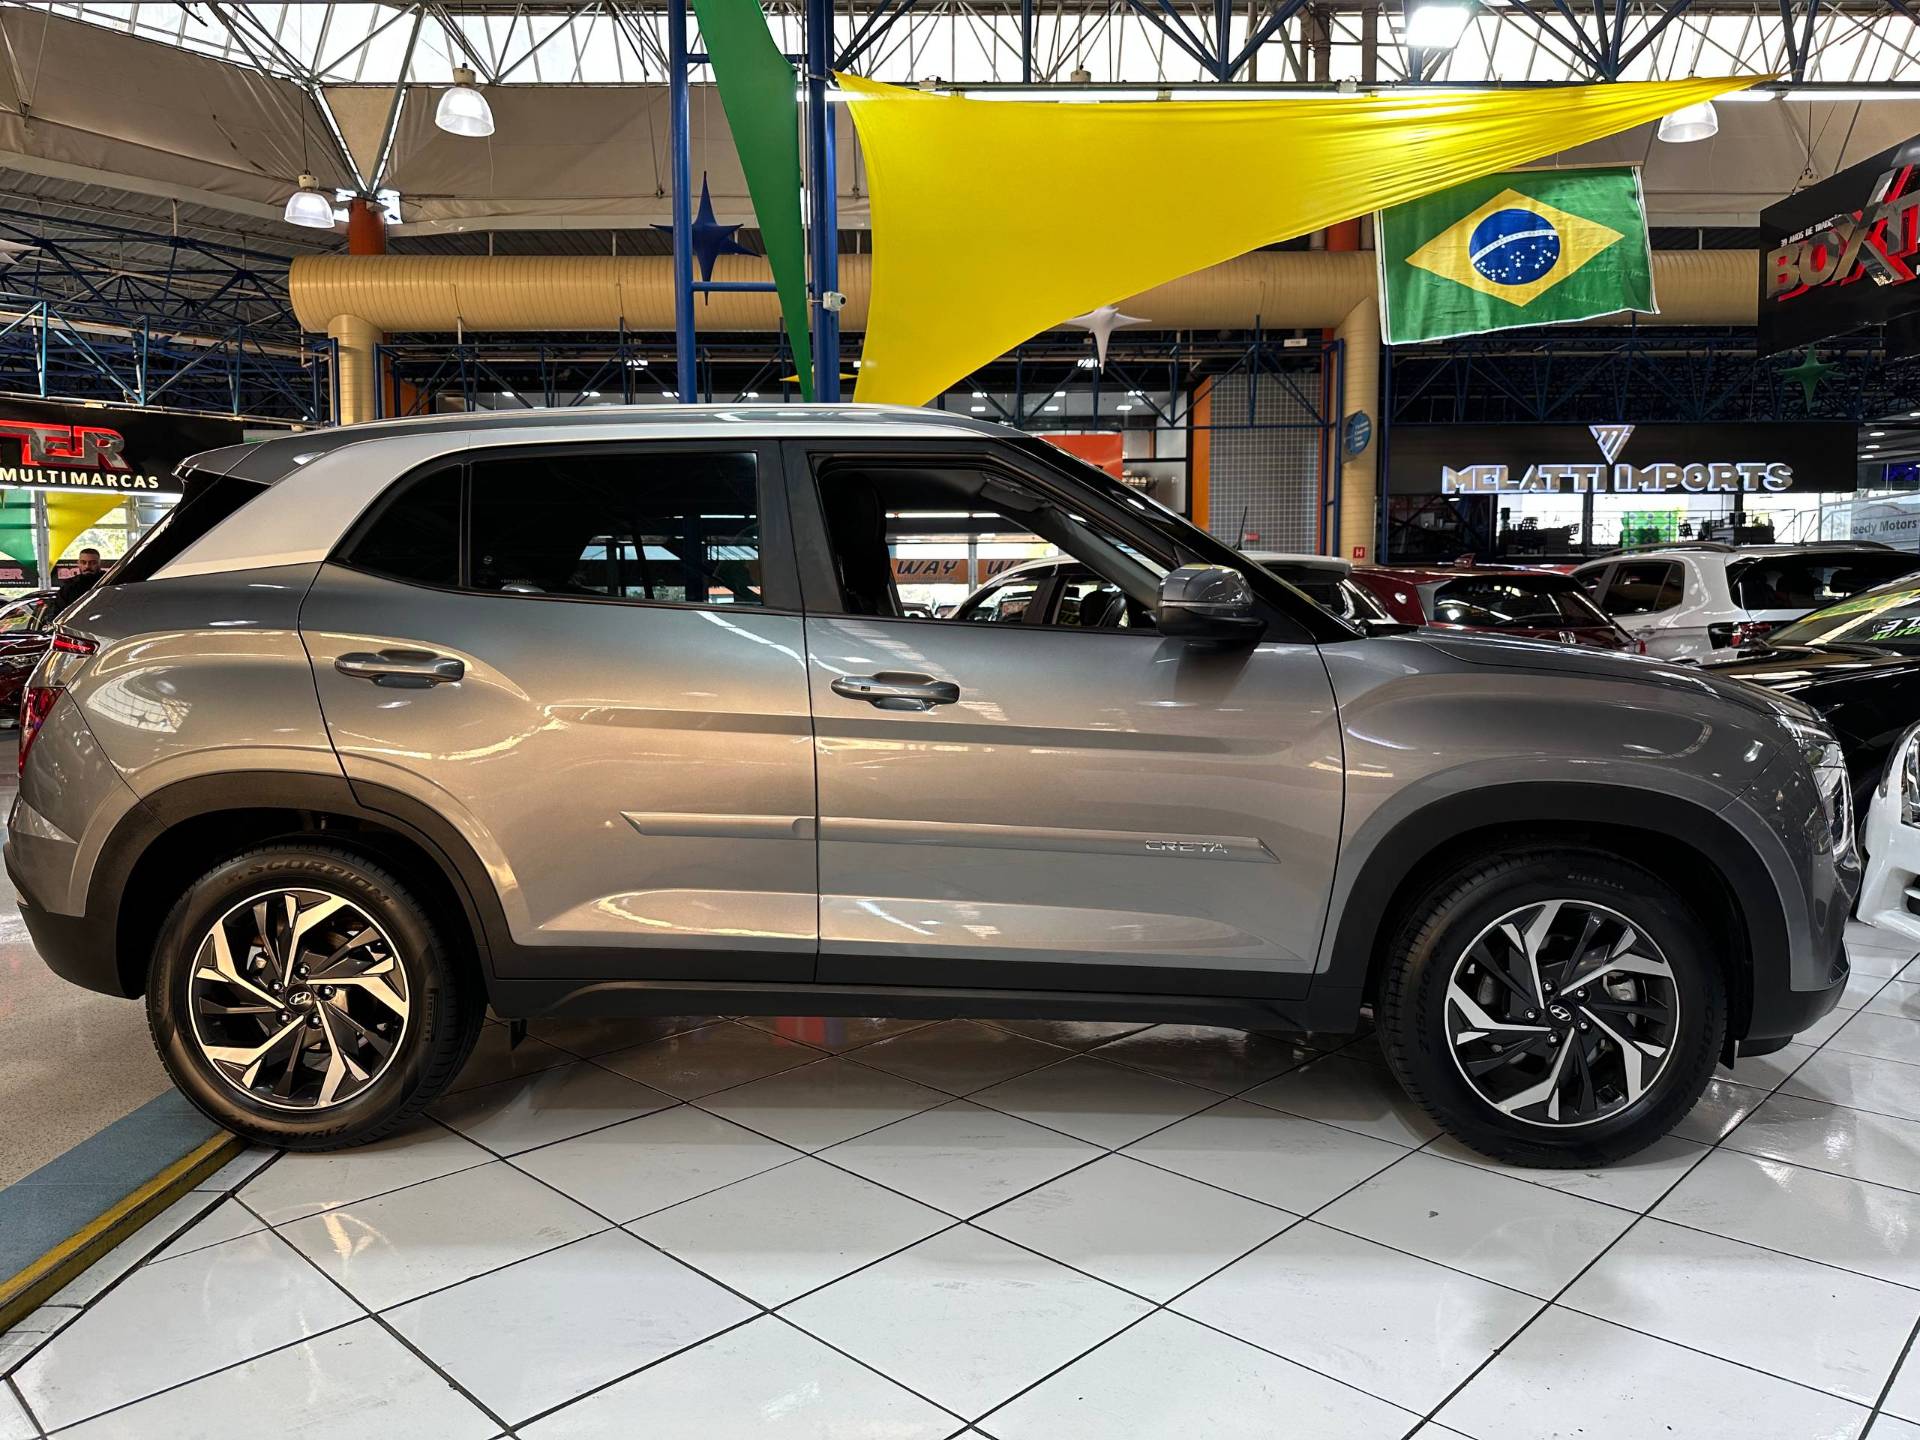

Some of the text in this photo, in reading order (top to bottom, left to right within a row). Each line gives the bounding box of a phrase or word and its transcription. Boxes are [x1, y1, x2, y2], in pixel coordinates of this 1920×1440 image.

[0, 467, 159, 489] MULTIMARCAS
[1442, 463, 1795, 494] MELATTI IMPORTS
[1850, 519, 1918, 537] eedy Motors
[896, 560, 958, 575] WAY
[1145, 840, 1228, 854] CRETA
